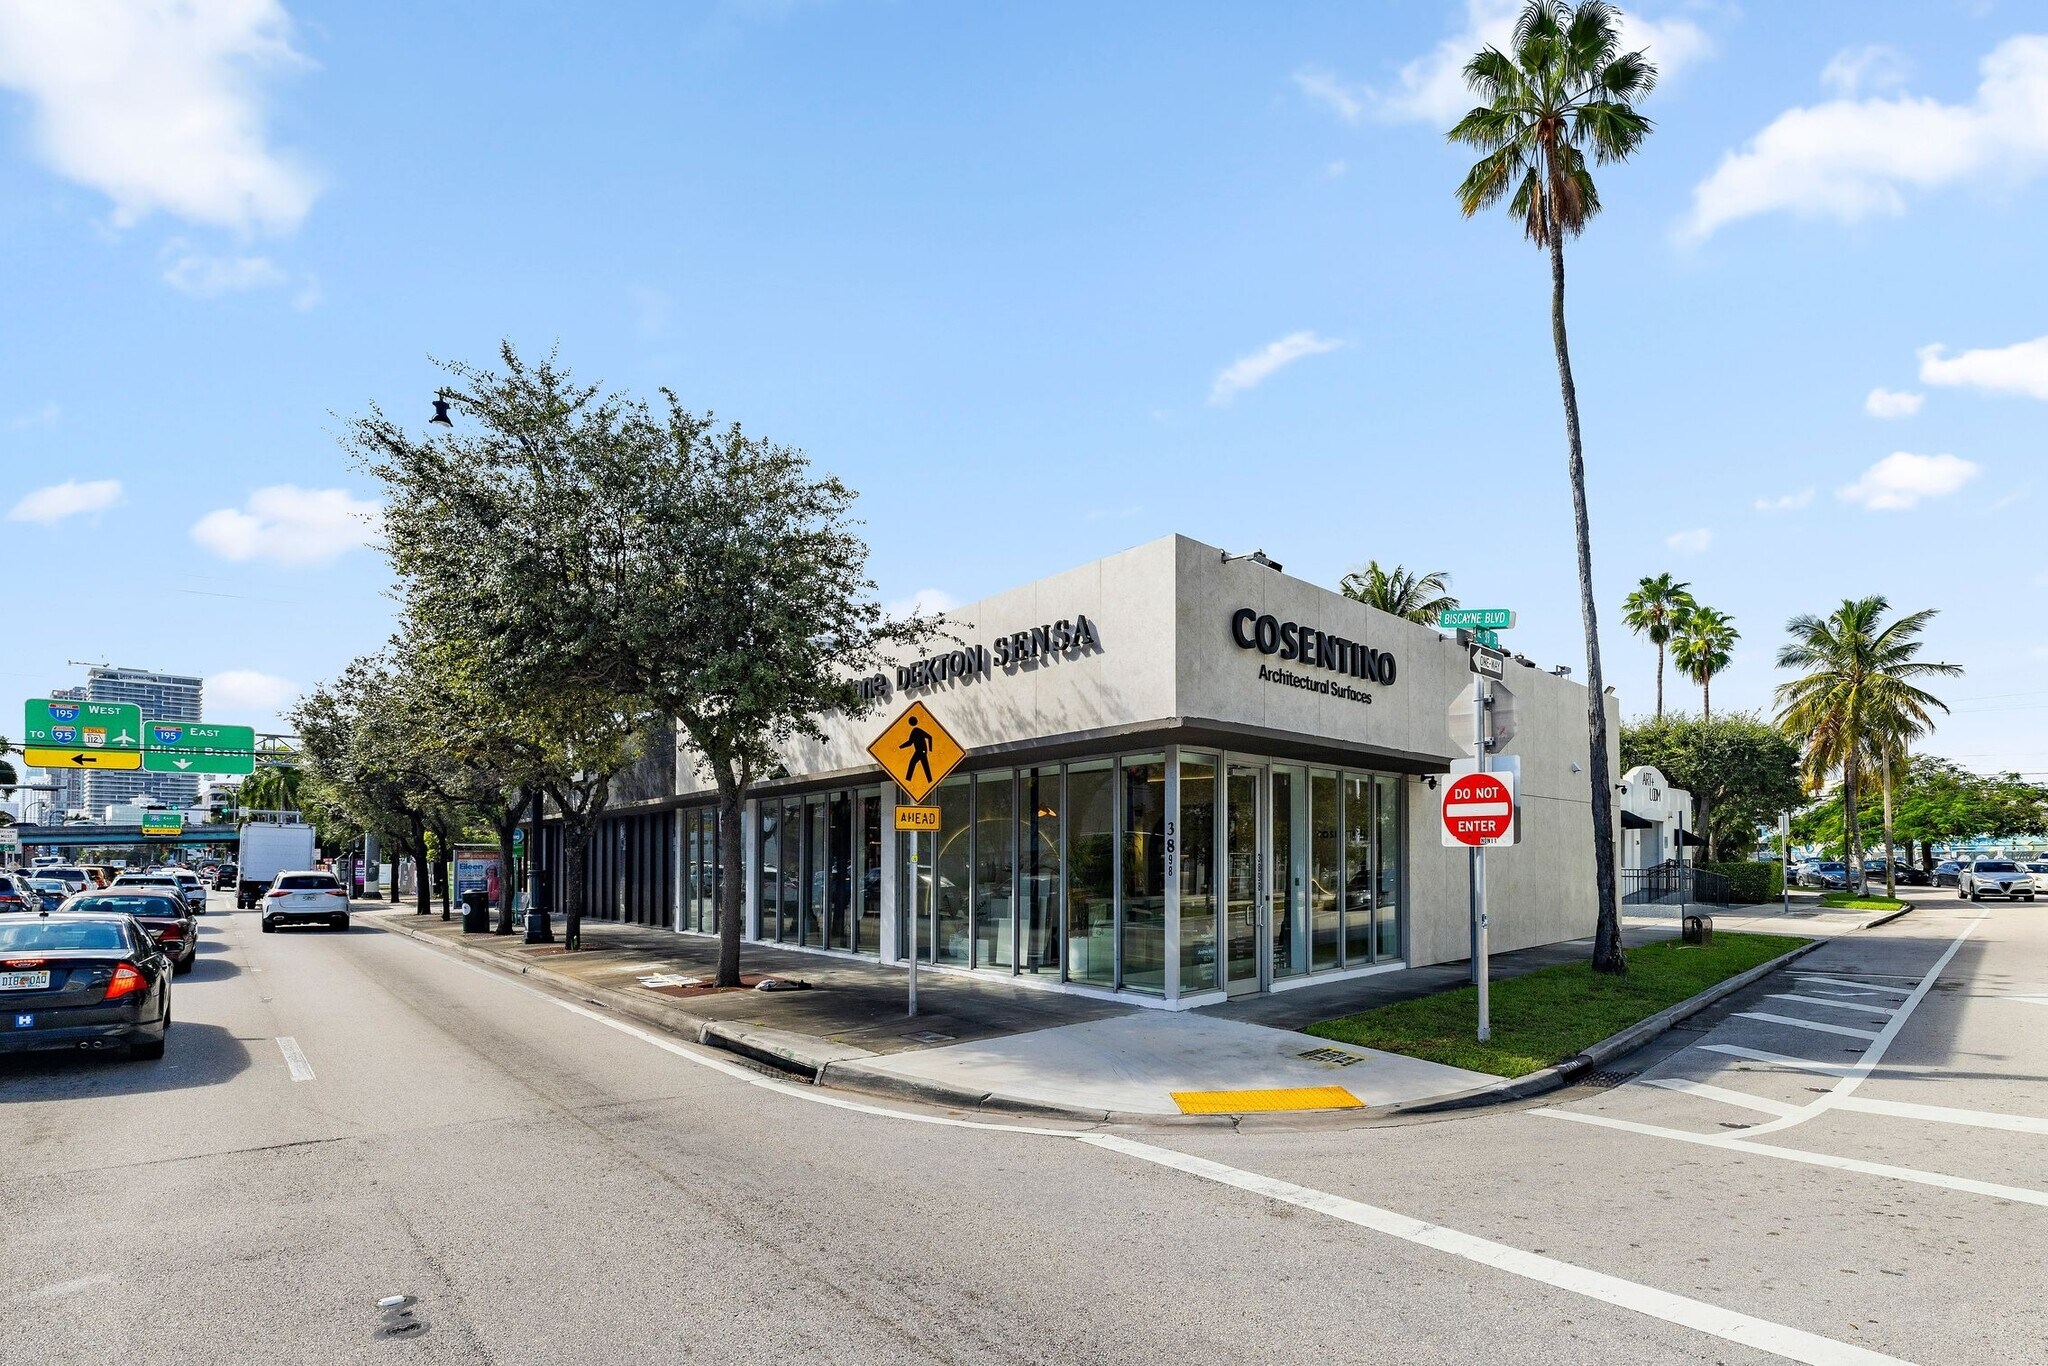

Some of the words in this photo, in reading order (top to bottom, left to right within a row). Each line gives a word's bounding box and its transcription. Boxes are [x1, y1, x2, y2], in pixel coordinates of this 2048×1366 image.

[1444, 612, 1482, 625] BISCAYNE
[1484, 612, 1506, 624] BLVD
[896, 644, 982, 691] DEKTON
[993, 614, 1094, 667] SENSA
[1231, 608, 1397, 686] COSENTINO
[1258, 664, 1330, 695] Architectural
[1330, 681, 1372, 705] Surfaces
[56, 709, 73, 719] 195
[88, 705, 121, 715] WEST
[29, 730, 45, 738] TO
[55, 732, 72, 740] 95
[160, 732, 177, 740] 195
[190, 728, 220, 737] EAST
[150, 745, 197, 755] Miami
[204, 747, 248, 757] Beach
[1454, 788, 1471, 800] DO
[1475, 786, 1499, 799] NOT
[900, 812, 936, 825] AHEAD
[1457, 820, 1496, 832] ENTER
[1167, 822, 1175, 877] 3898
